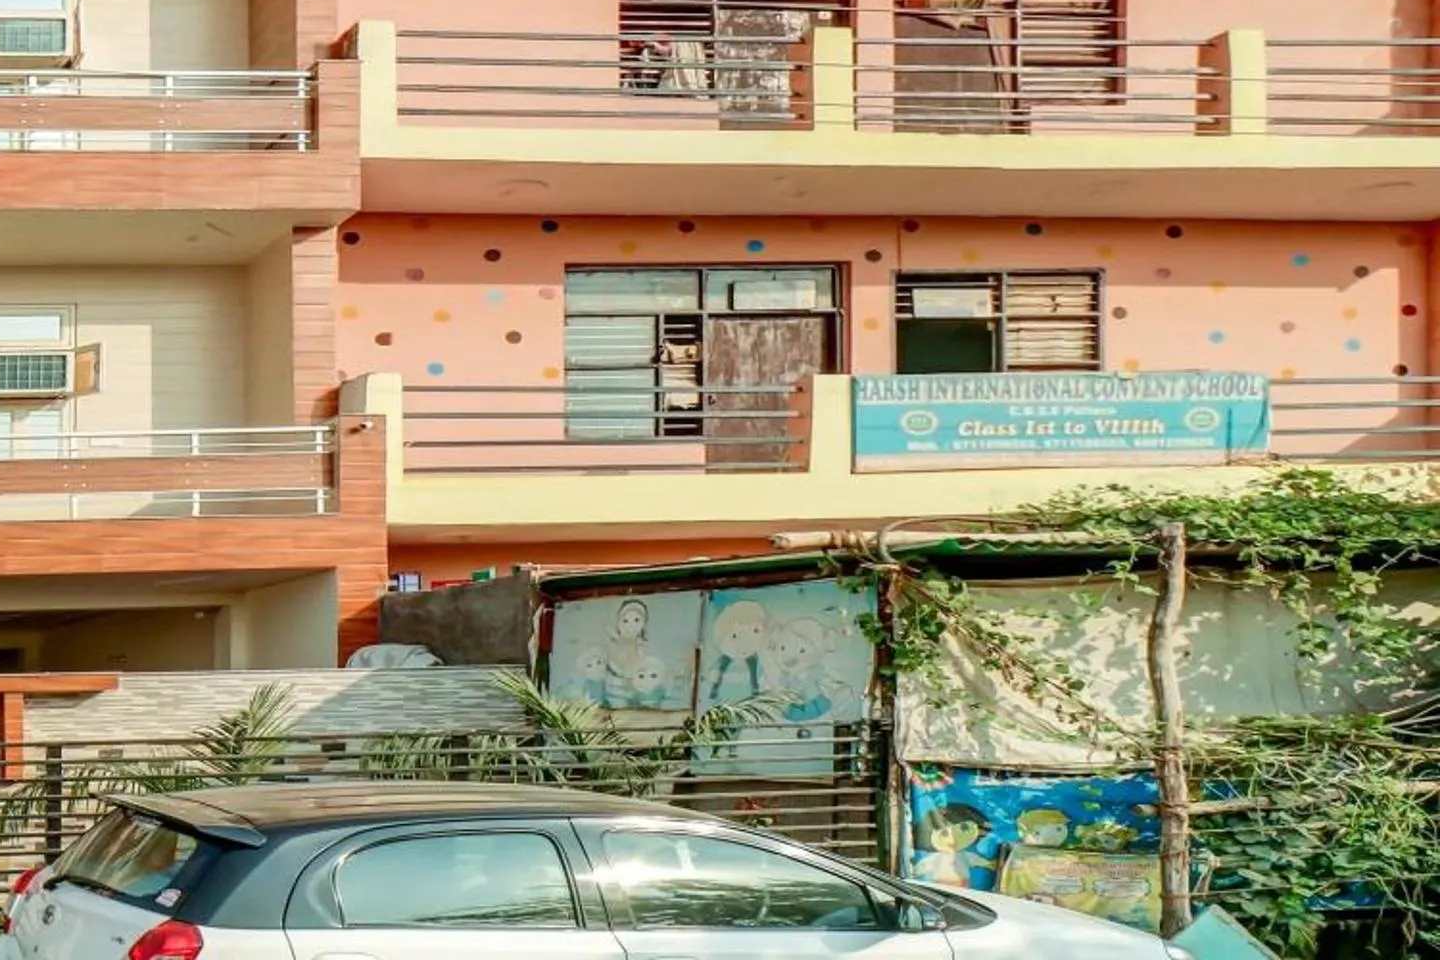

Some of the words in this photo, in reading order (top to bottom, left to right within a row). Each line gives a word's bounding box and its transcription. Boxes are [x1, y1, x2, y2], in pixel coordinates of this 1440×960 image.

[857, 378, 920, 401] HARSH
[928, 376, 1084, 400] INTERNATIONAL
[1182, 374, 1258, 398] SCHOOL
[957, 421, 1018, 437] Class
[1063, 420, 1087, 436] to
